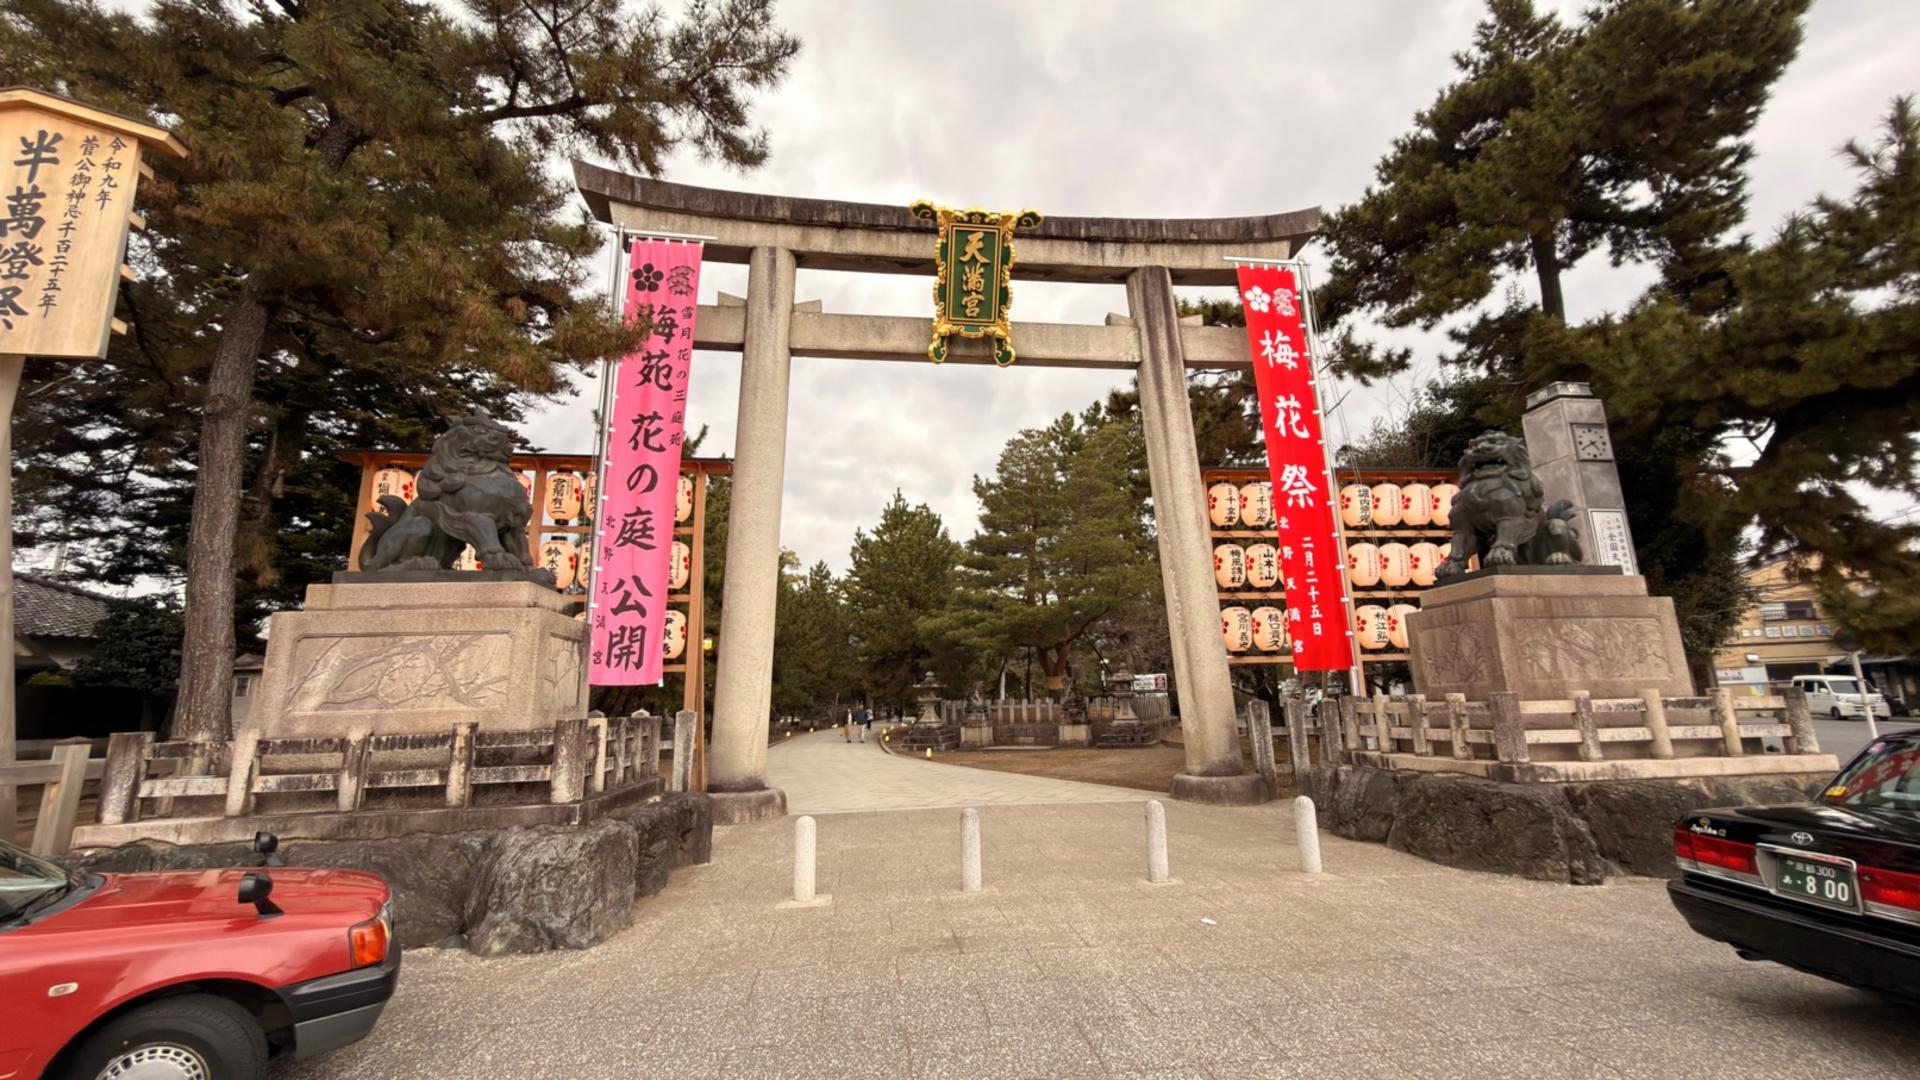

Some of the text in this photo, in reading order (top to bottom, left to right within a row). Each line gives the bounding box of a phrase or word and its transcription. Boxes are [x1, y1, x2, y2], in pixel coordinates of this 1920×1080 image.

[37, 135, 100, 318] 菅公御神忌千百二十五年
[95, 136, 127, 211] 令和九年
[1259, 329, 1318, 508] 梅花祭
[1279, 516, 1304, 653] 北野天満宮
[1301, 536, 1323, 636] 二月二十五日
